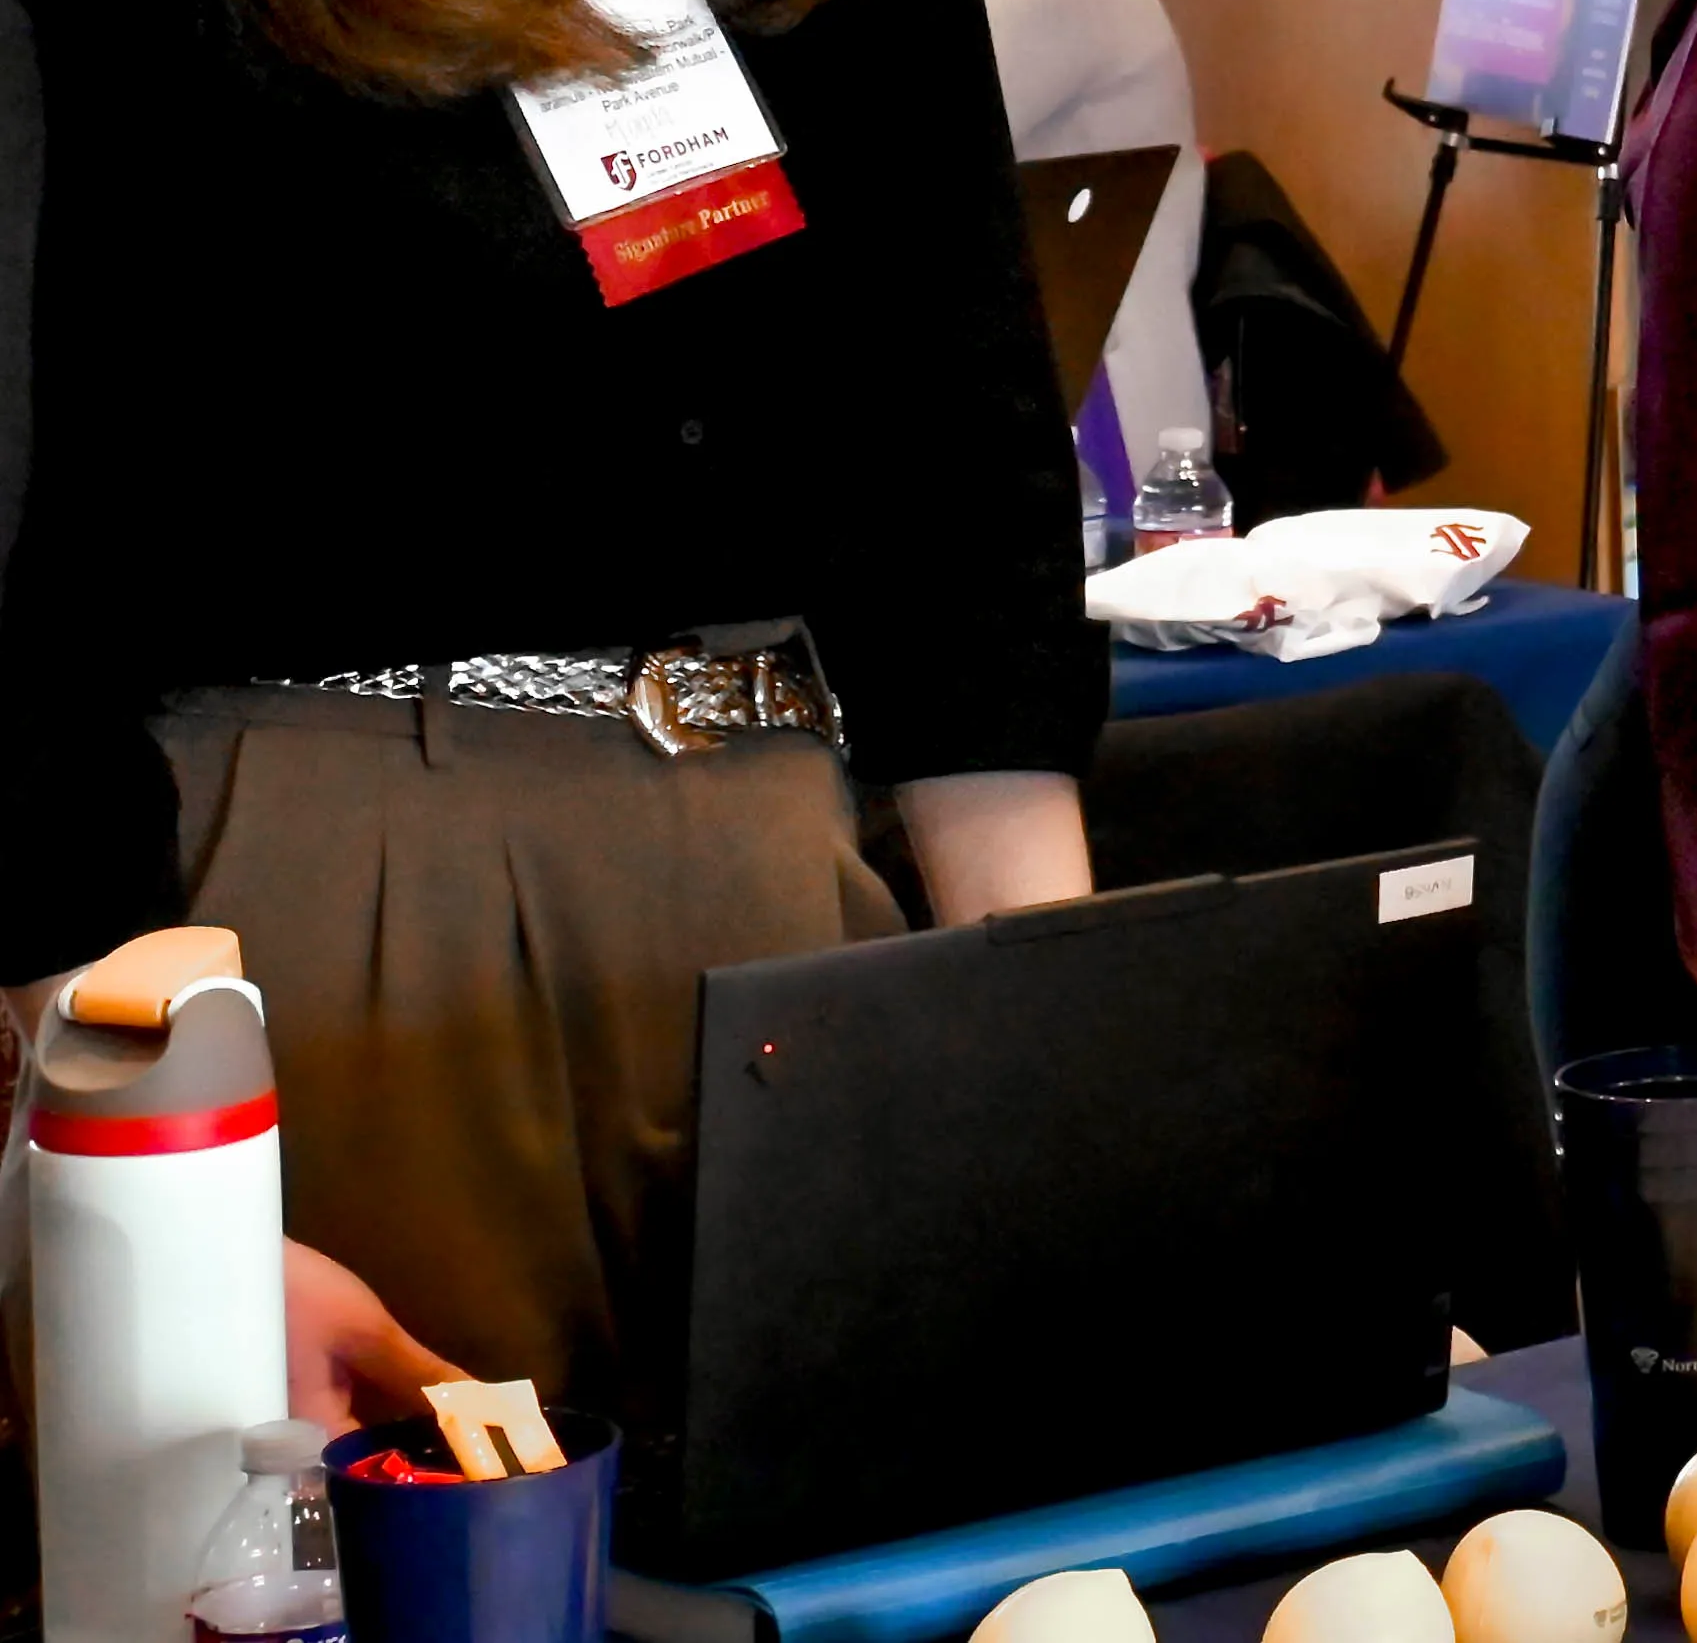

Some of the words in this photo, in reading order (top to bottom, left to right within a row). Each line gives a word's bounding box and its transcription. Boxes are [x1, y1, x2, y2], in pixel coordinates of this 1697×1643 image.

[675, 47, 718, 70] Mutual
[601, 93, 631, 113] Park
[634, 80, 680, 104] Avenue
[636, 126, 729, 169] FORDHAM
[613, 219, 697, 264] Signature
[698, 190, 770, 230] Partner
